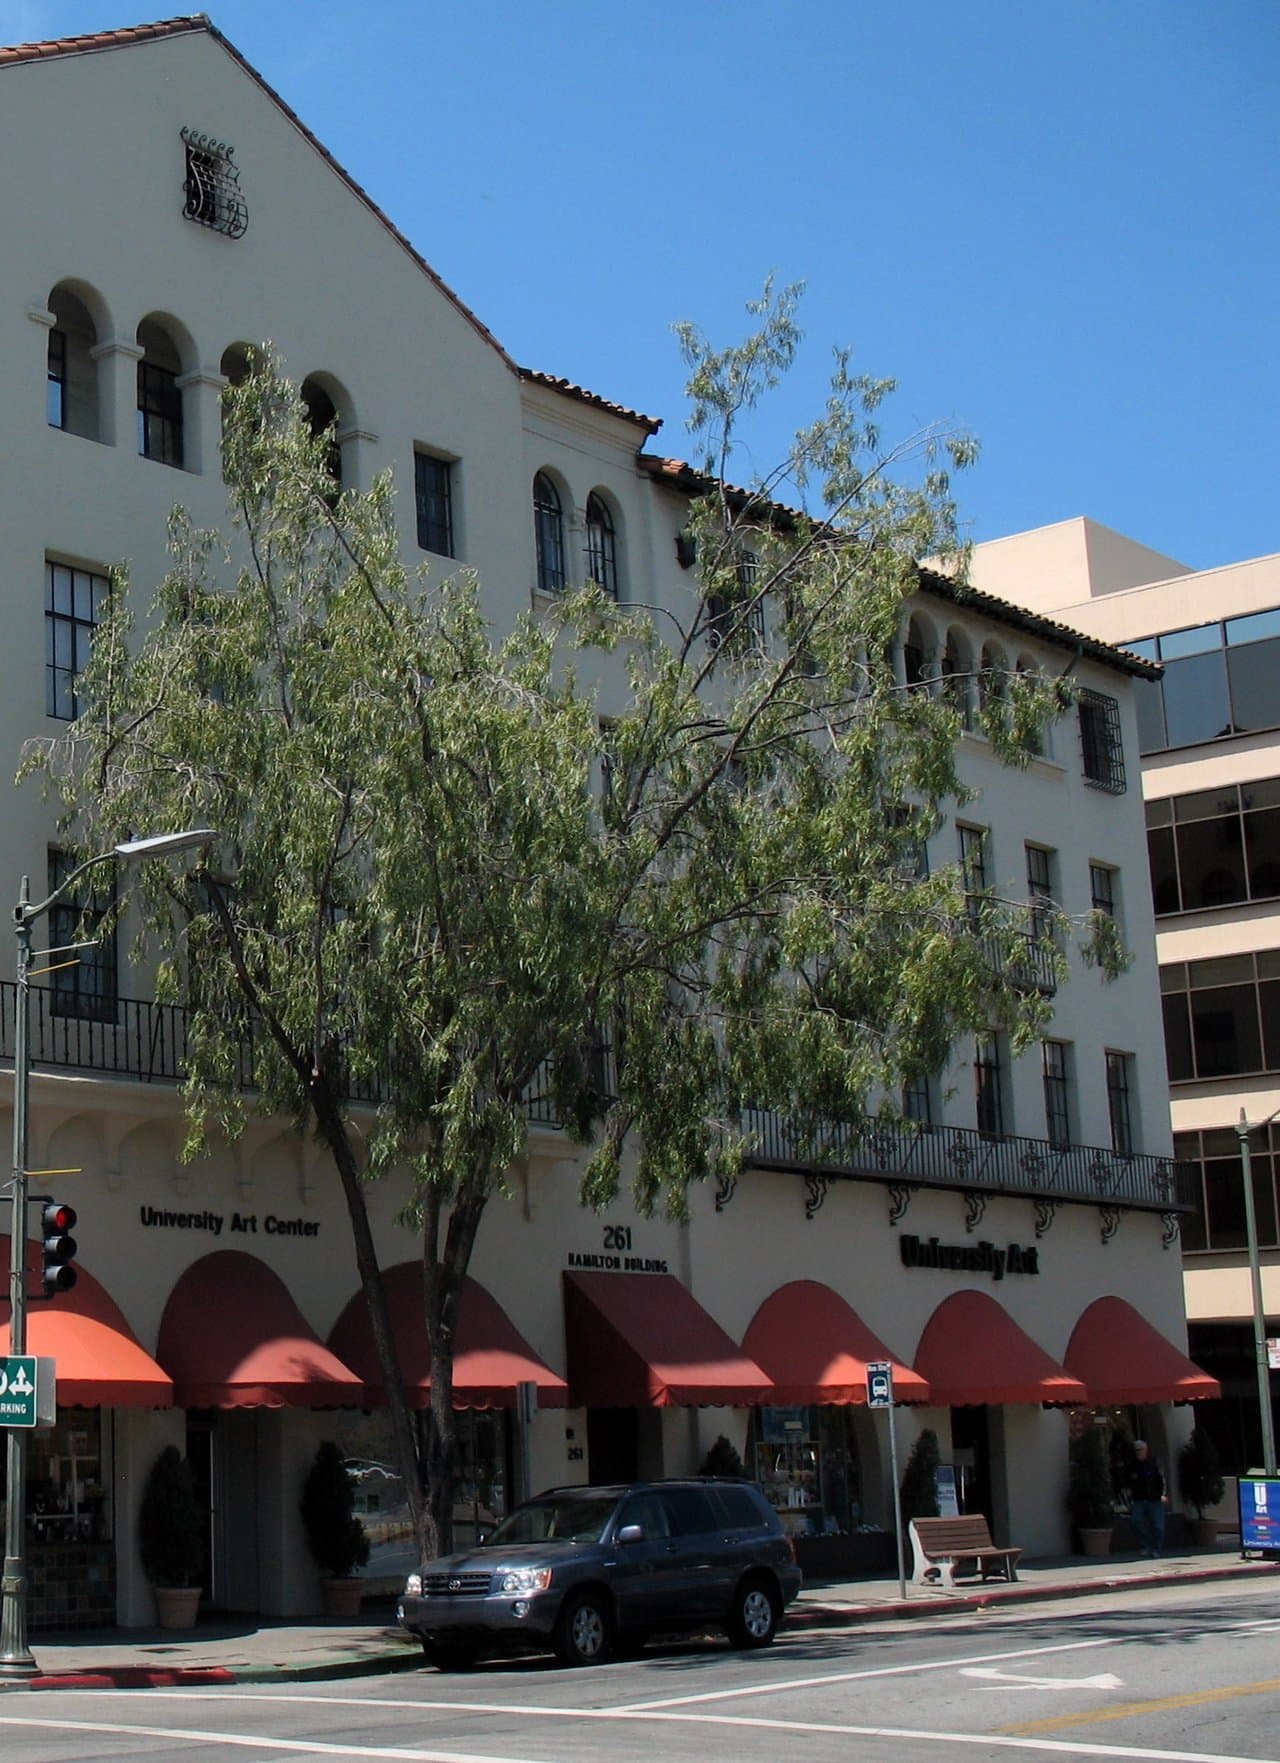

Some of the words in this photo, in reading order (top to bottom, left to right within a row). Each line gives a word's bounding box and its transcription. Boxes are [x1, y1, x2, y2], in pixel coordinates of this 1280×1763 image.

[140, 1206, 223, 1235] University
[231, 1213, 257, 1233] Art
[264, 1216, 320, 1236] Center
[603, 1225, 632, 1250] 261
[568, 1253, 621, 1270] HAMILTON
[624, 1257, 668, 1273] BUILDING
[900, 1234, 1006, 1281] University
[1007, 1243, 1040, 1274] Art
